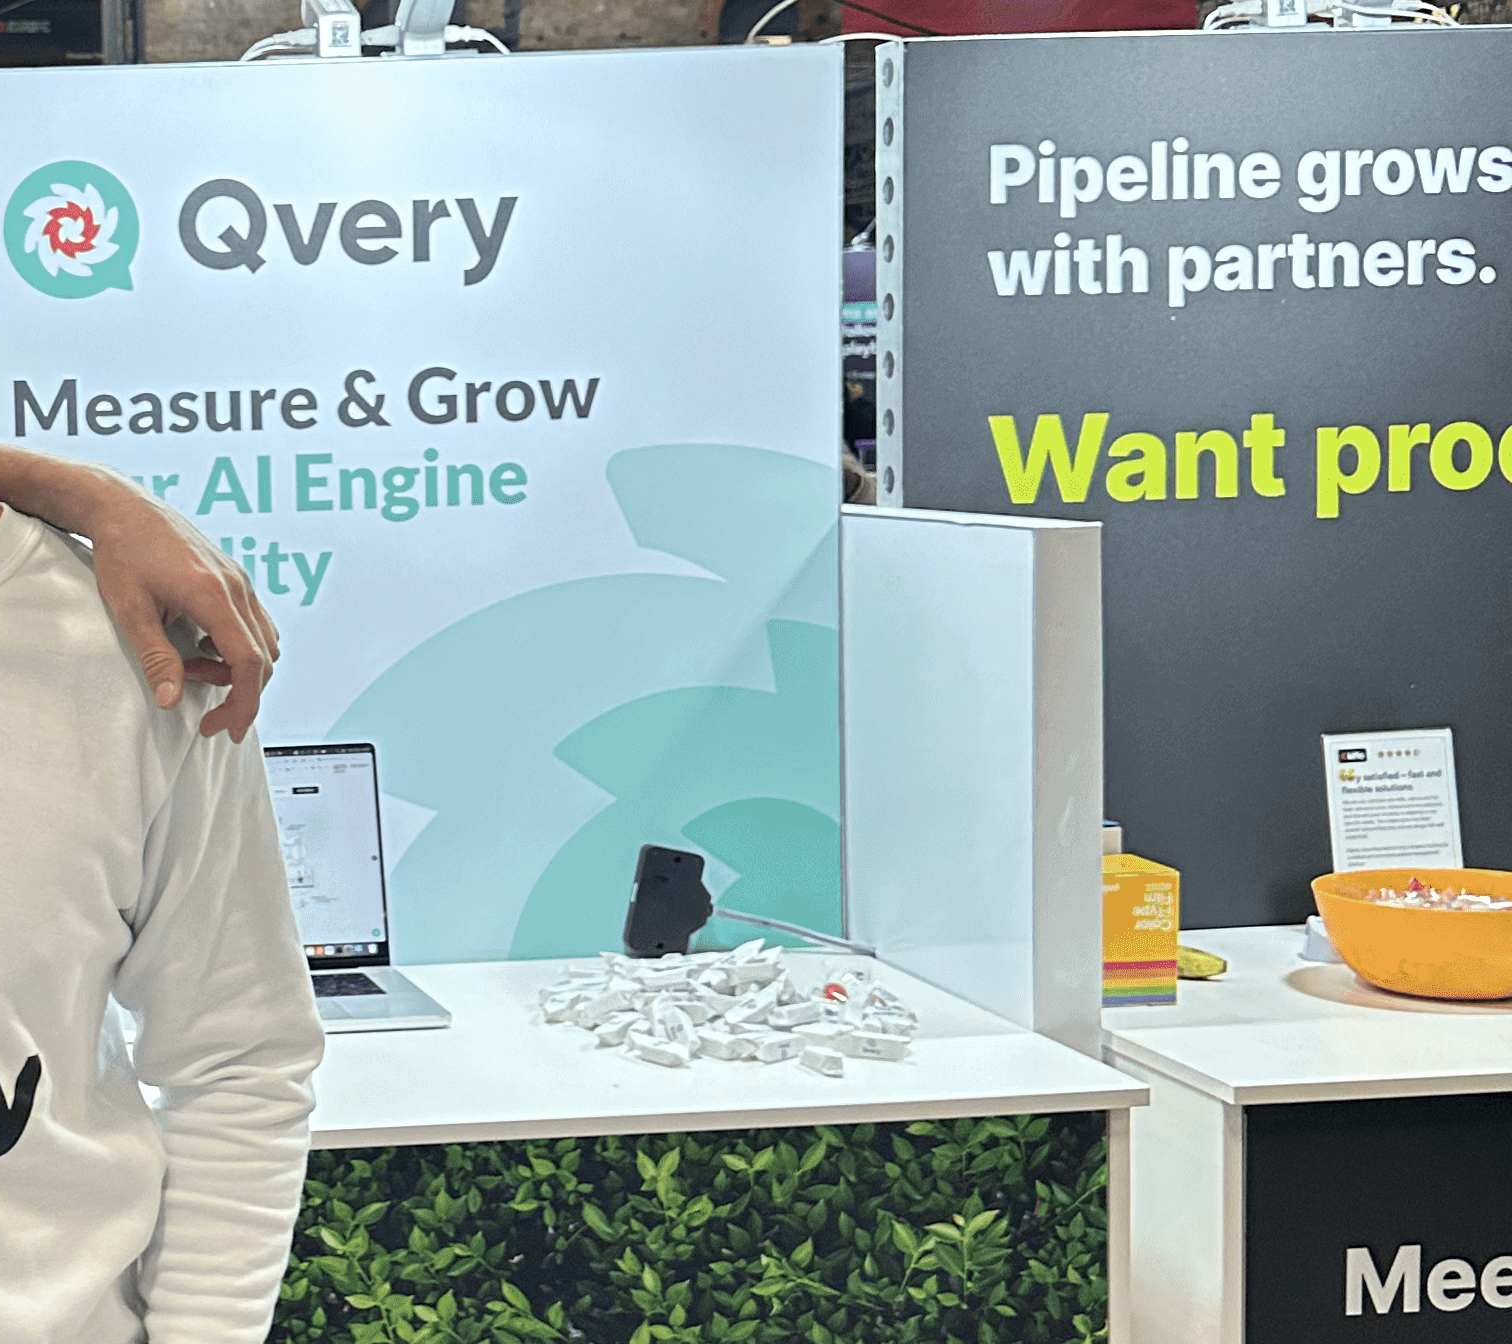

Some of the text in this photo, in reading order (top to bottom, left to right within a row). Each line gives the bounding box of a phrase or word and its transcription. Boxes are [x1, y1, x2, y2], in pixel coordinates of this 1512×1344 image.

[989, 137, 1512, 218] Pipeline grows
[178, 177, 519, 286] Qvery
[987, 232, 1497, 308] with partners.
[13, 365, 601, 437] Measure & Grow
[196, 455, 273, 515] AI
[296, 448, 529, 523] Engine
[988, 412, 1512, 519] Want pro
